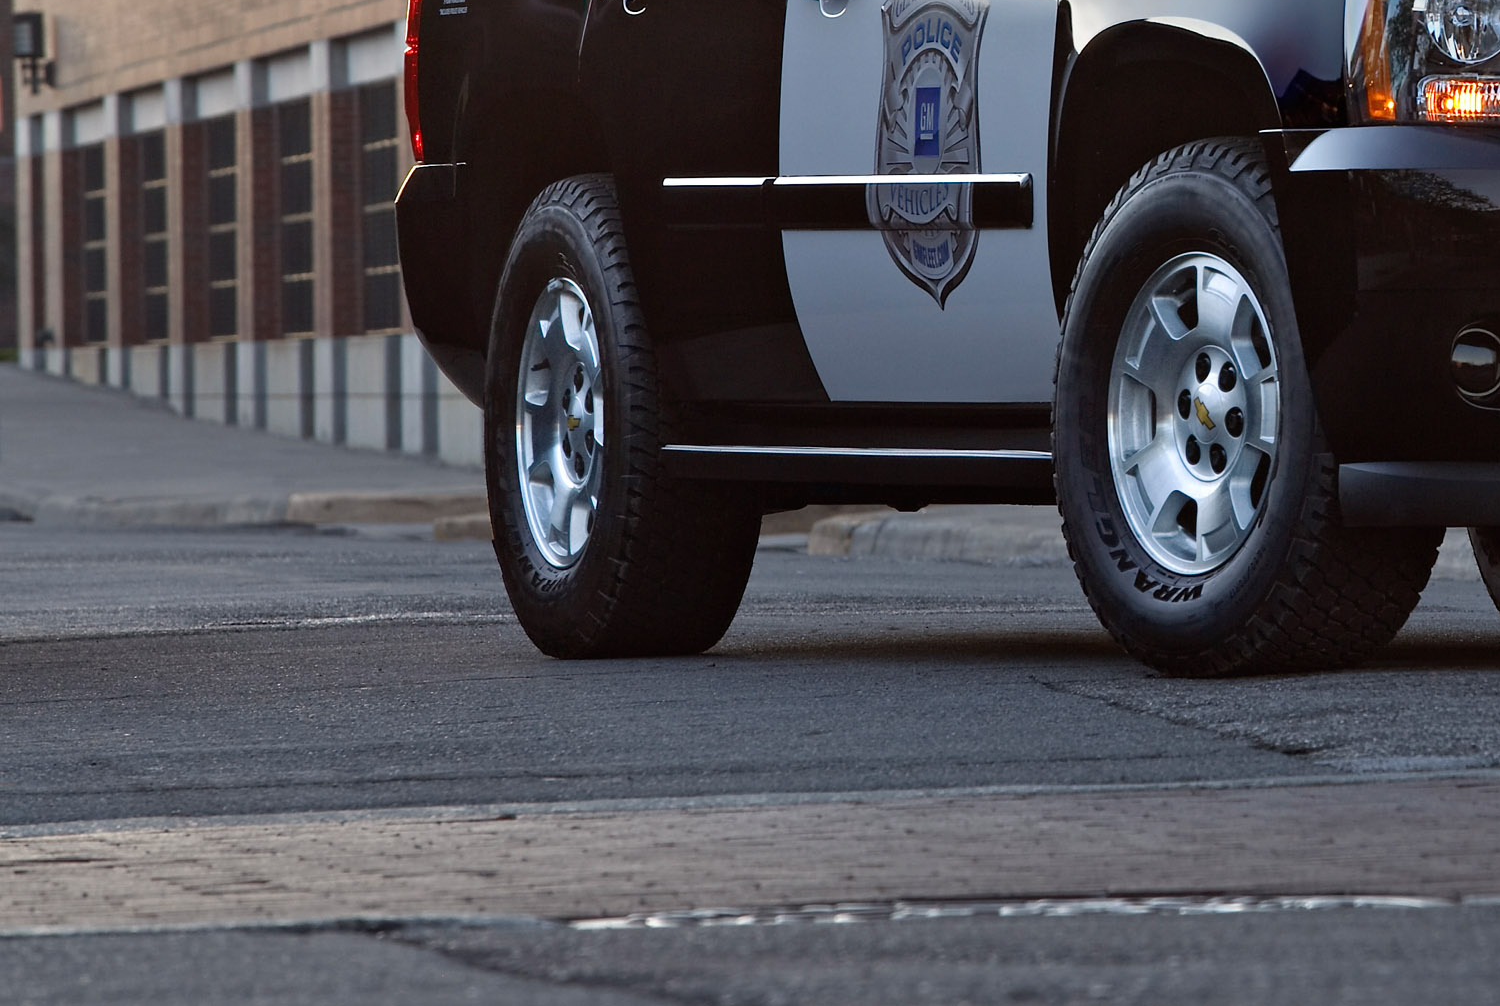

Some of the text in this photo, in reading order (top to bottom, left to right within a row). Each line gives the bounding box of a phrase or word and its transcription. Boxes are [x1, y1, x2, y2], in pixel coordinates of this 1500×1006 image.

[901, 17, 962, 67] POLICE
[920, 102, 935, 131] GM
[890, 182, 949, 216] VEHICLES
